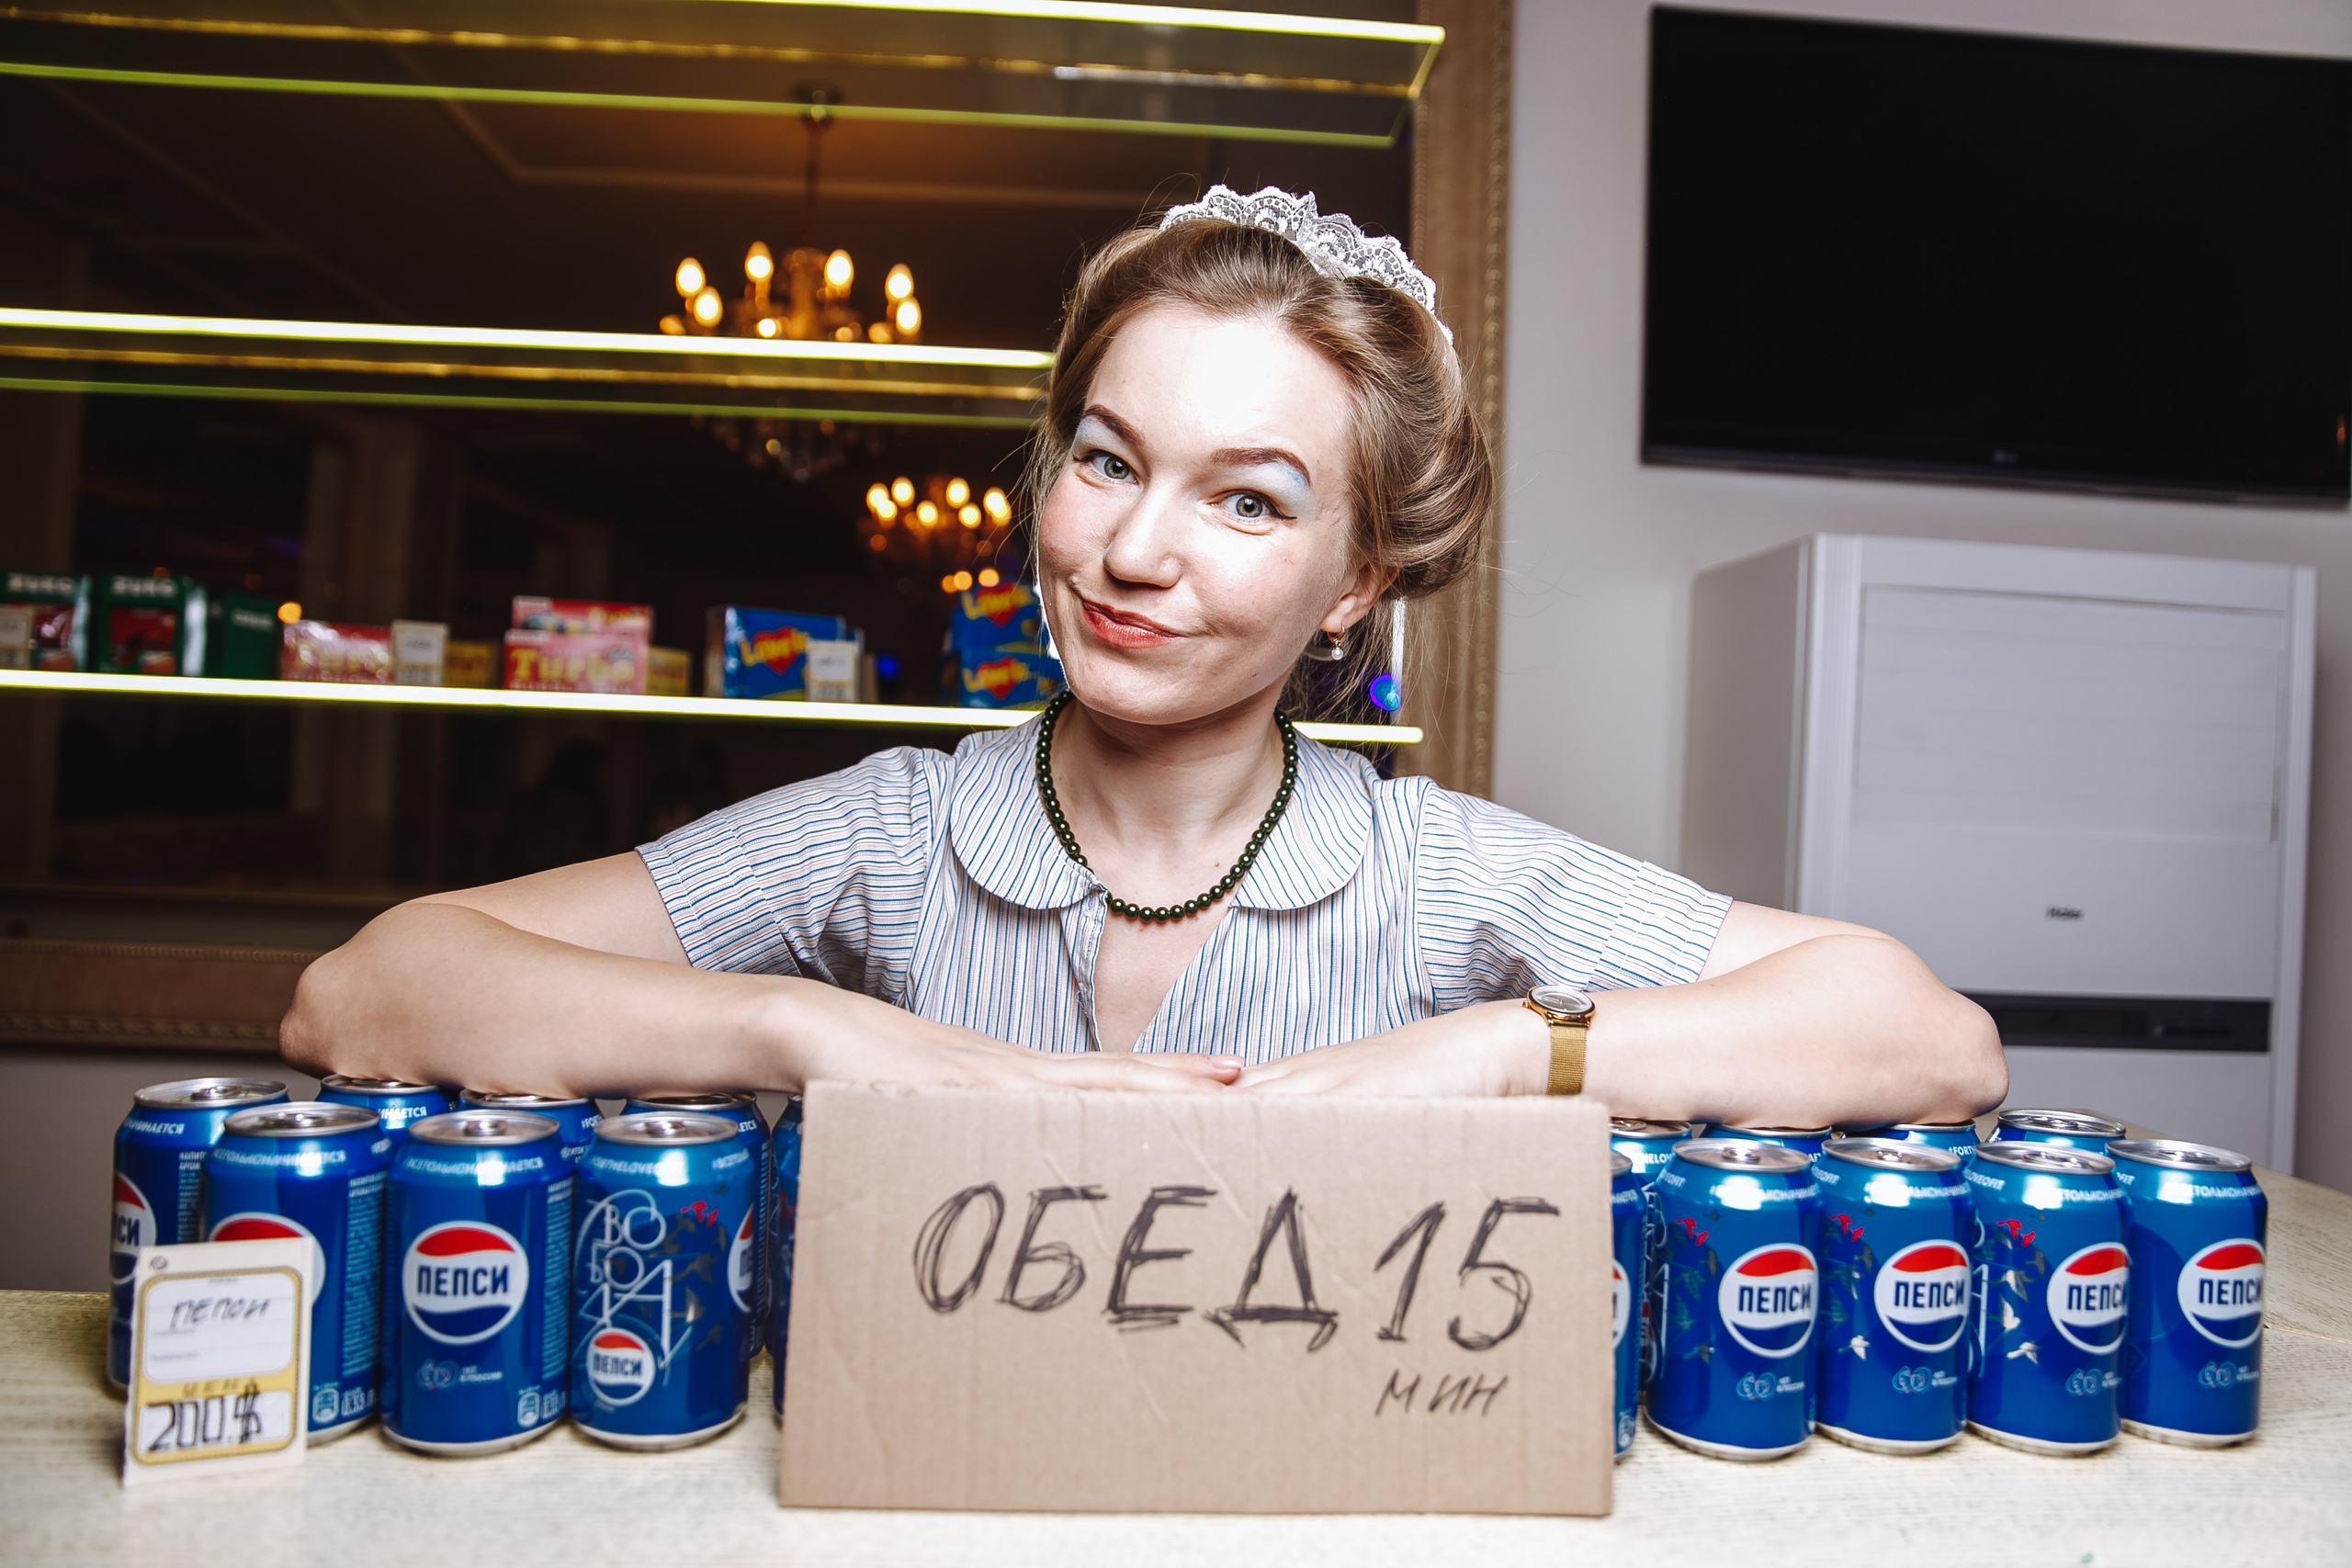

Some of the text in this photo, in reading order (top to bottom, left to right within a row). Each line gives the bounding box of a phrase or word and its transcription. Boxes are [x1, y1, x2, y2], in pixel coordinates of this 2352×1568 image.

[113, 1211, 141, 1246] СИ
[417, 1265, 509, 1298] ПЕПСИ
[913, 1184, 1340, 1353] ОБЕД
[1372, 1197, 1560, 1352] 15
[1737, 1282, 1812, 1314] ПЕПСИ
[1894, 1278, 1965, 1309] ПЕПСИ
[169, 1297, 272, 1330] ПЕПСИ
[593, 1352, 643, 1376] ПЕПСИ
